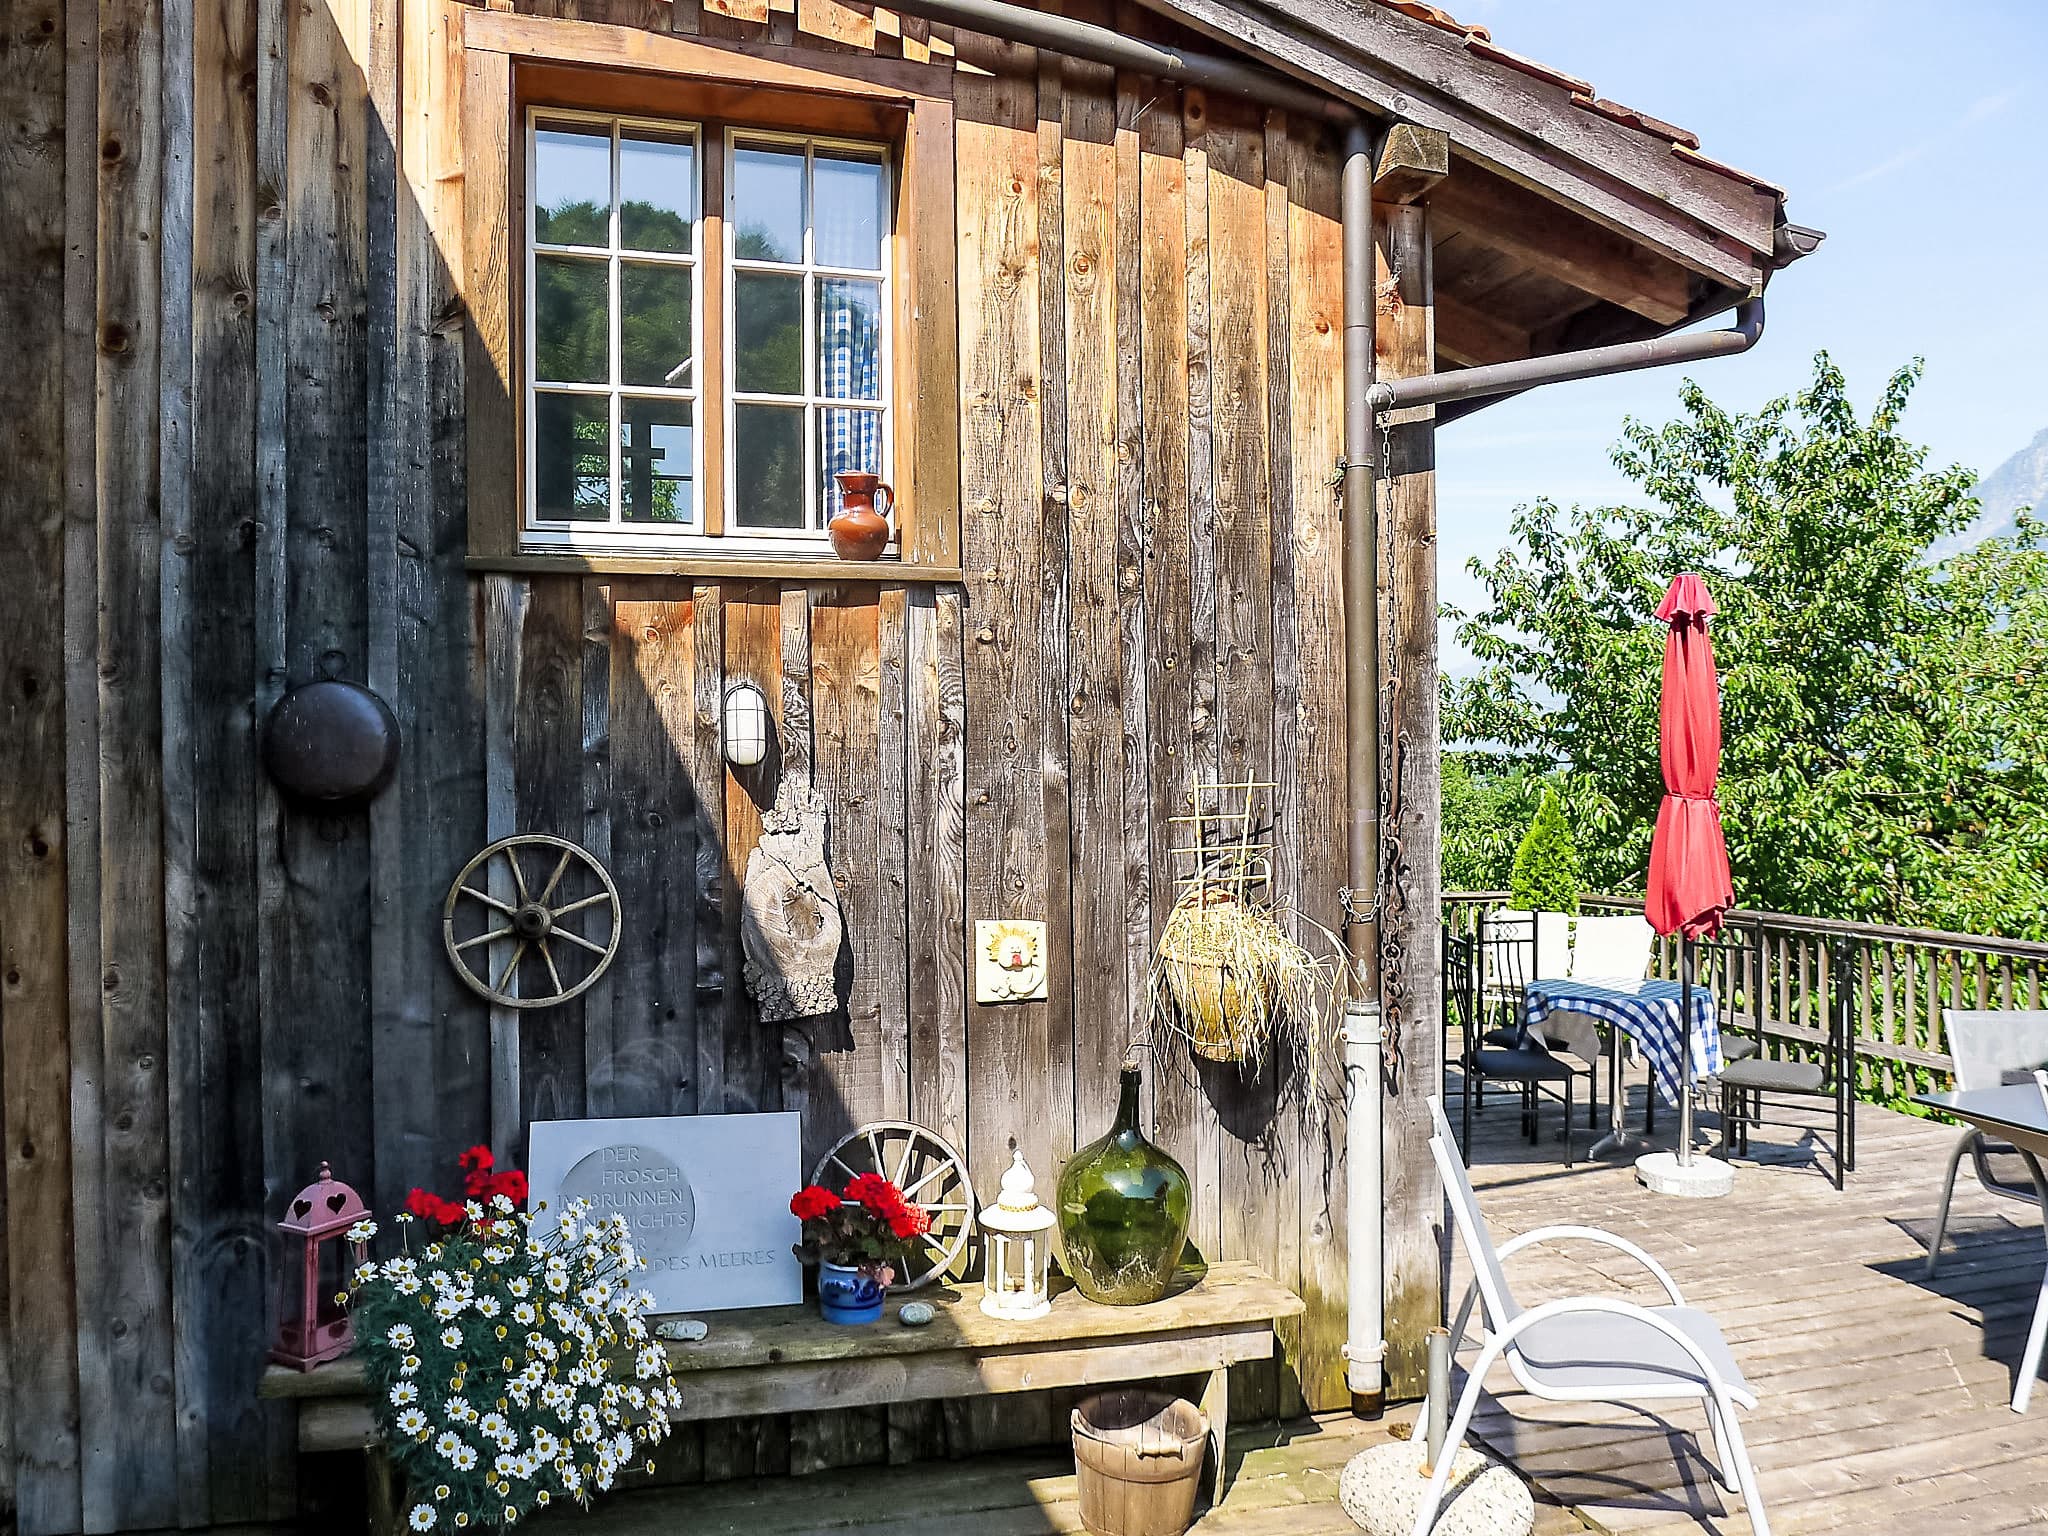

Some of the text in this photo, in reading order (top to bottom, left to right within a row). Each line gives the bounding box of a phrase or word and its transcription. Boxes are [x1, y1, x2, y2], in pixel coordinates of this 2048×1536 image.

[602, 1146, 640, 1163] DER
[602, 1167, 680, 1186] FROSCH
[588, 1188, 683, 1209] BRUNNEN
[653, 1256, 690, 1273] DES
[698, 1249, 777, 1271] MEERES
